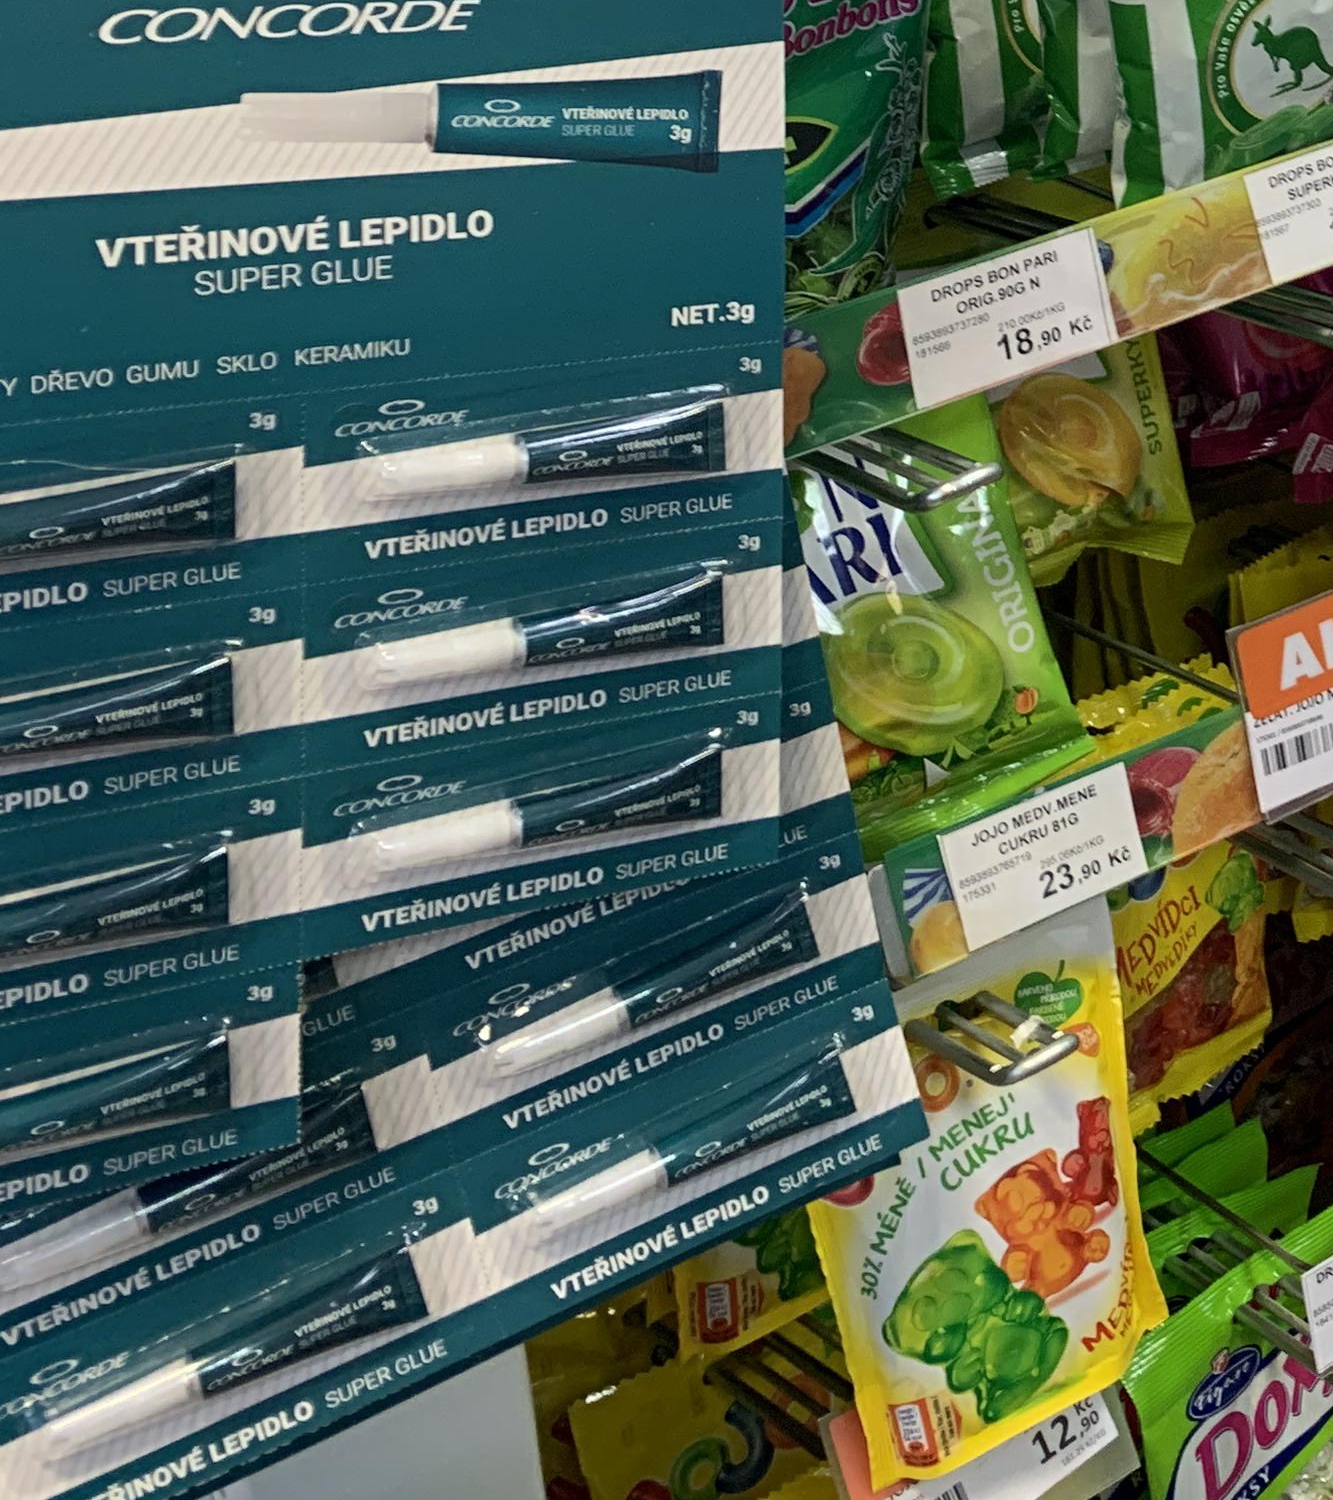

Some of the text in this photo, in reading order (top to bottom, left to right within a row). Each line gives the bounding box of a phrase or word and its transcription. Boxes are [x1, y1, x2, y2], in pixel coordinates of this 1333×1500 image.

[561, 106, 689, 122] VTEŘINOVÉ LEPIDLO
[561, 122, 635, 138] SUPER GLUE
[668, 124, 693, 144] 3g
[1267, 161, 1314, 189] DROPS
[95, 209, 495, 269] VTEŘINOVÉ LEPIDLO
[193, 254, 394, 298] SUPER GLUE
[930, 248, 1059, 304] DROPS BON PARI
[1068, 314, 1094, 338] Kč
[30, 336, 412, 395] DŘEVO GUMU SKLO KERAMIKU
[738, 354, 762, 375] 3g
[363, 490, 734, 561] VTEŘINOVÉ LEPIDLO SUPER GLUE
[971, 818, 1009, 849] JOJO
[997, 810, 1080, 856] CUKRU 81G
[1106, 845, 1132, 868] Kč
[939, 1112, 1037, 1193] CUKRU
[549, 1132, 885, 1301] VTEŘINOVÉ LEPIDLO SUPER GLUE
